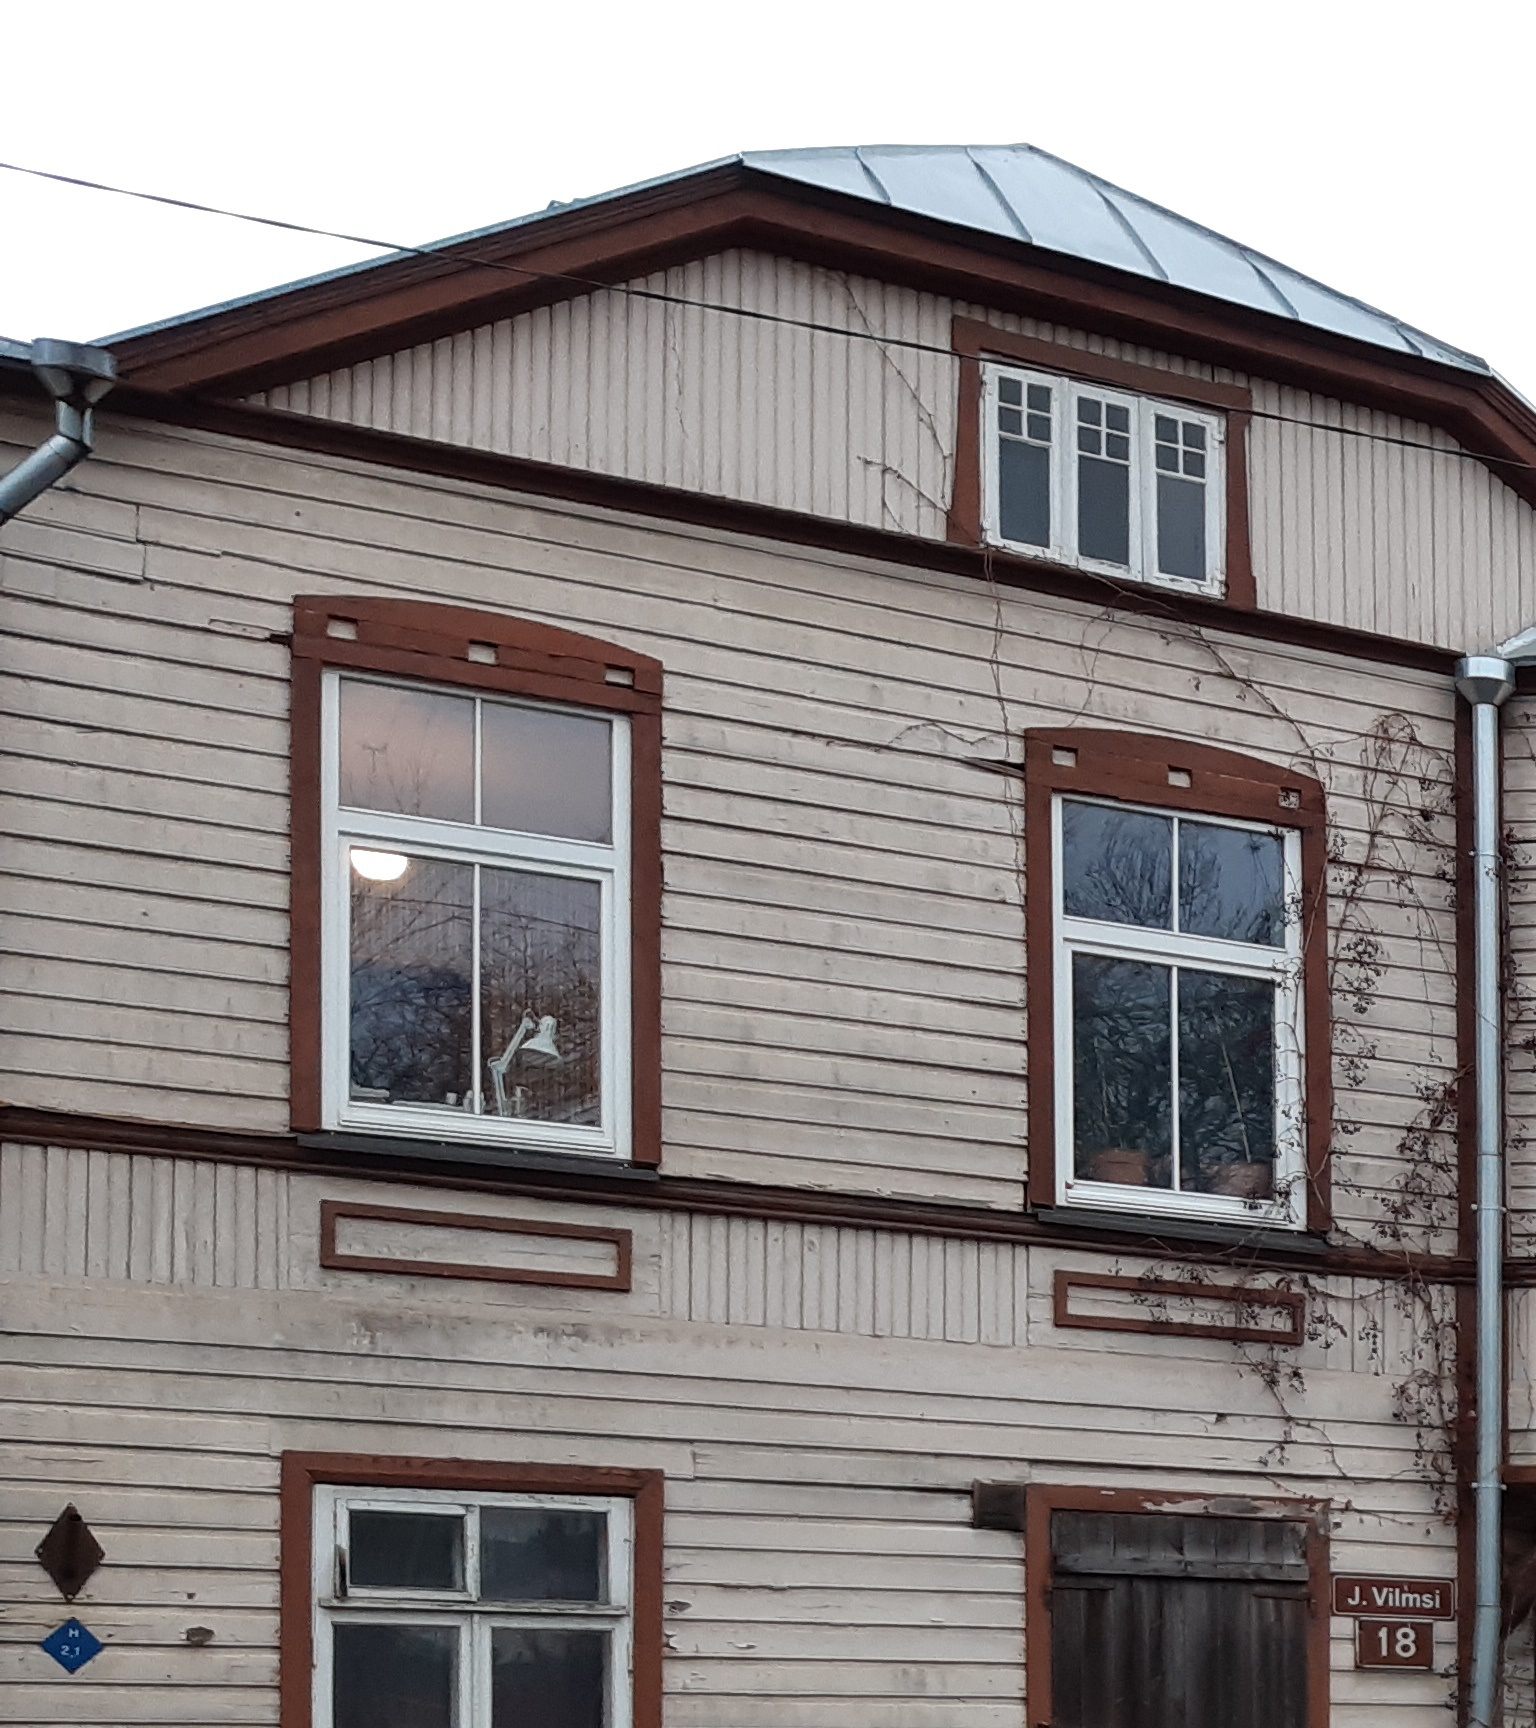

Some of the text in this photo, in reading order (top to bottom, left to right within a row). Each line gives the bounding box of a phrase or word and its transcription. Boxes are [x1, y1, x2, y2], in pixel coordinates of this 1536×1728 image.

[1347, 1586, 1441, 1610] J. Vilmsi
[68, 1628, 80, 1638] H
[1377, 1626, 1417, 1659] 18
